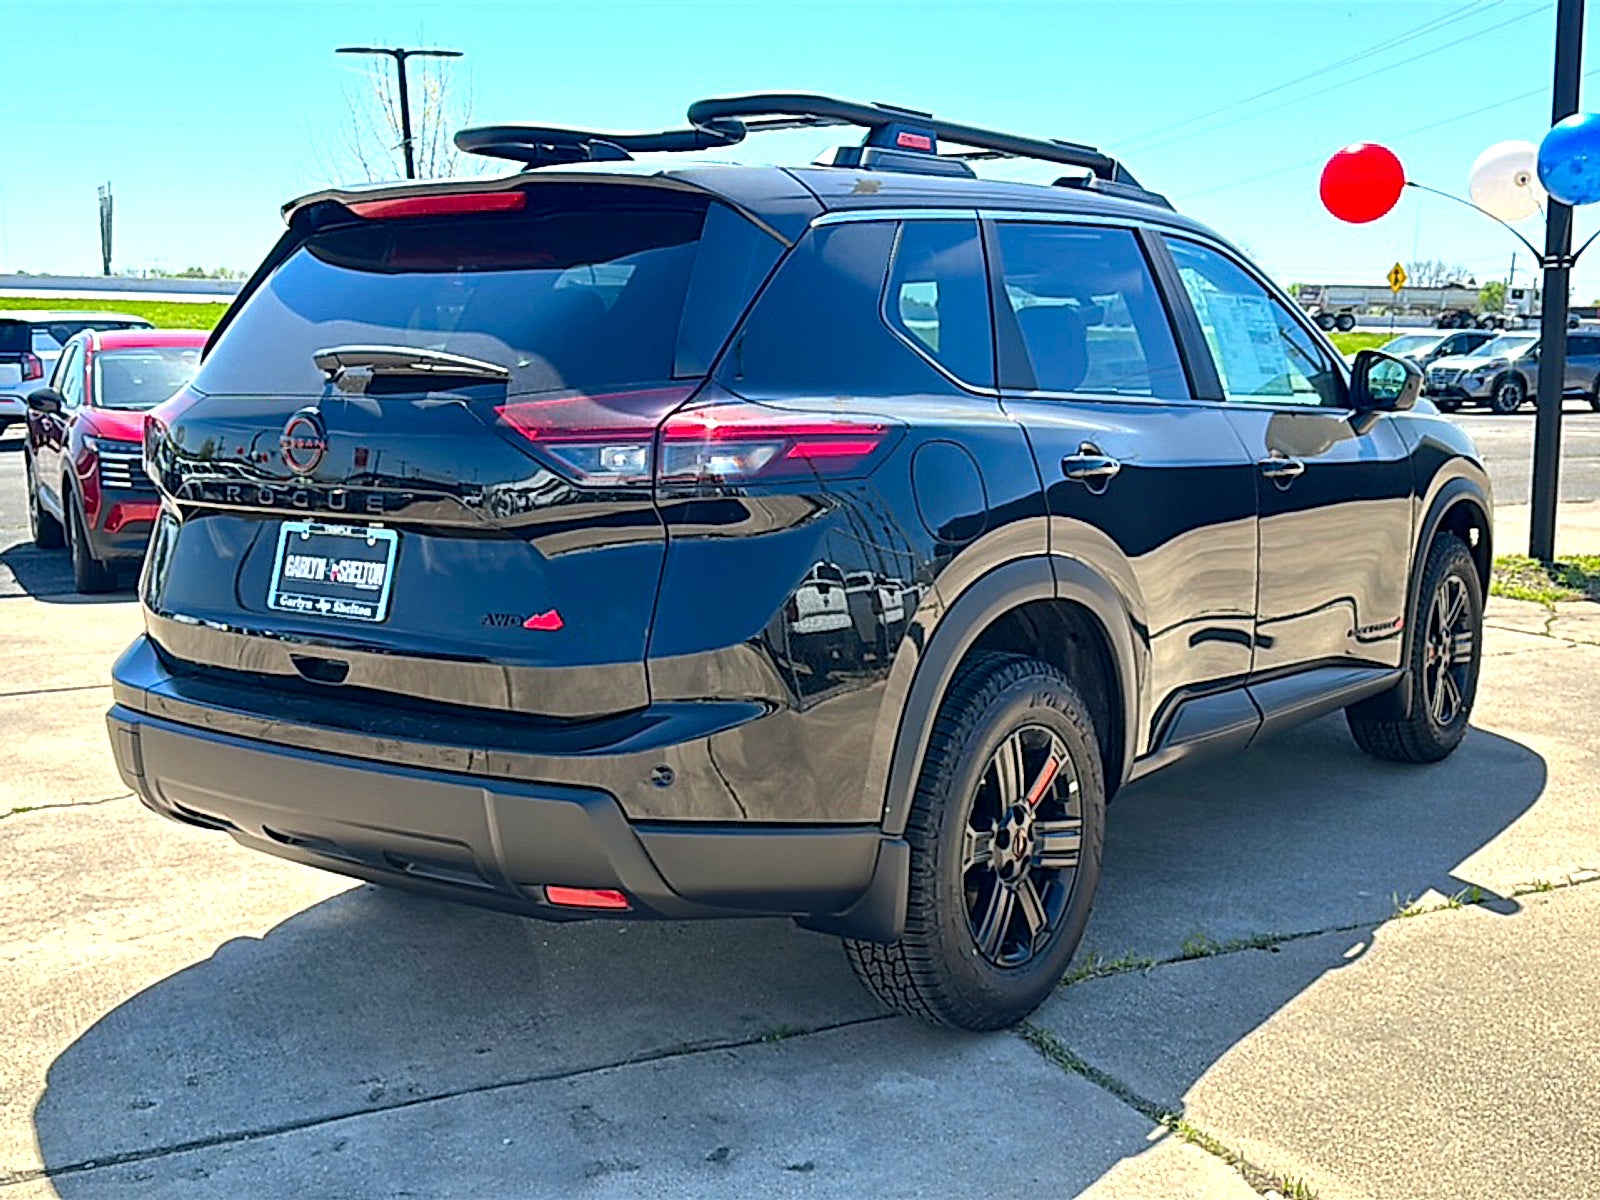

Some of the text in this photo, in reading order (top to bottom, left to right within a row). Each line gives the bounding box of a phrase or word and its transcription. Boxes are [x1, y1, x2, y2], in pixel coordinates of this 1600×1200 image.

[226, 484, 385, 515] ROGUE
[284, 554, 387, 586] GARLYN SHELTON
[332, 600, 373, 617] Shelton
